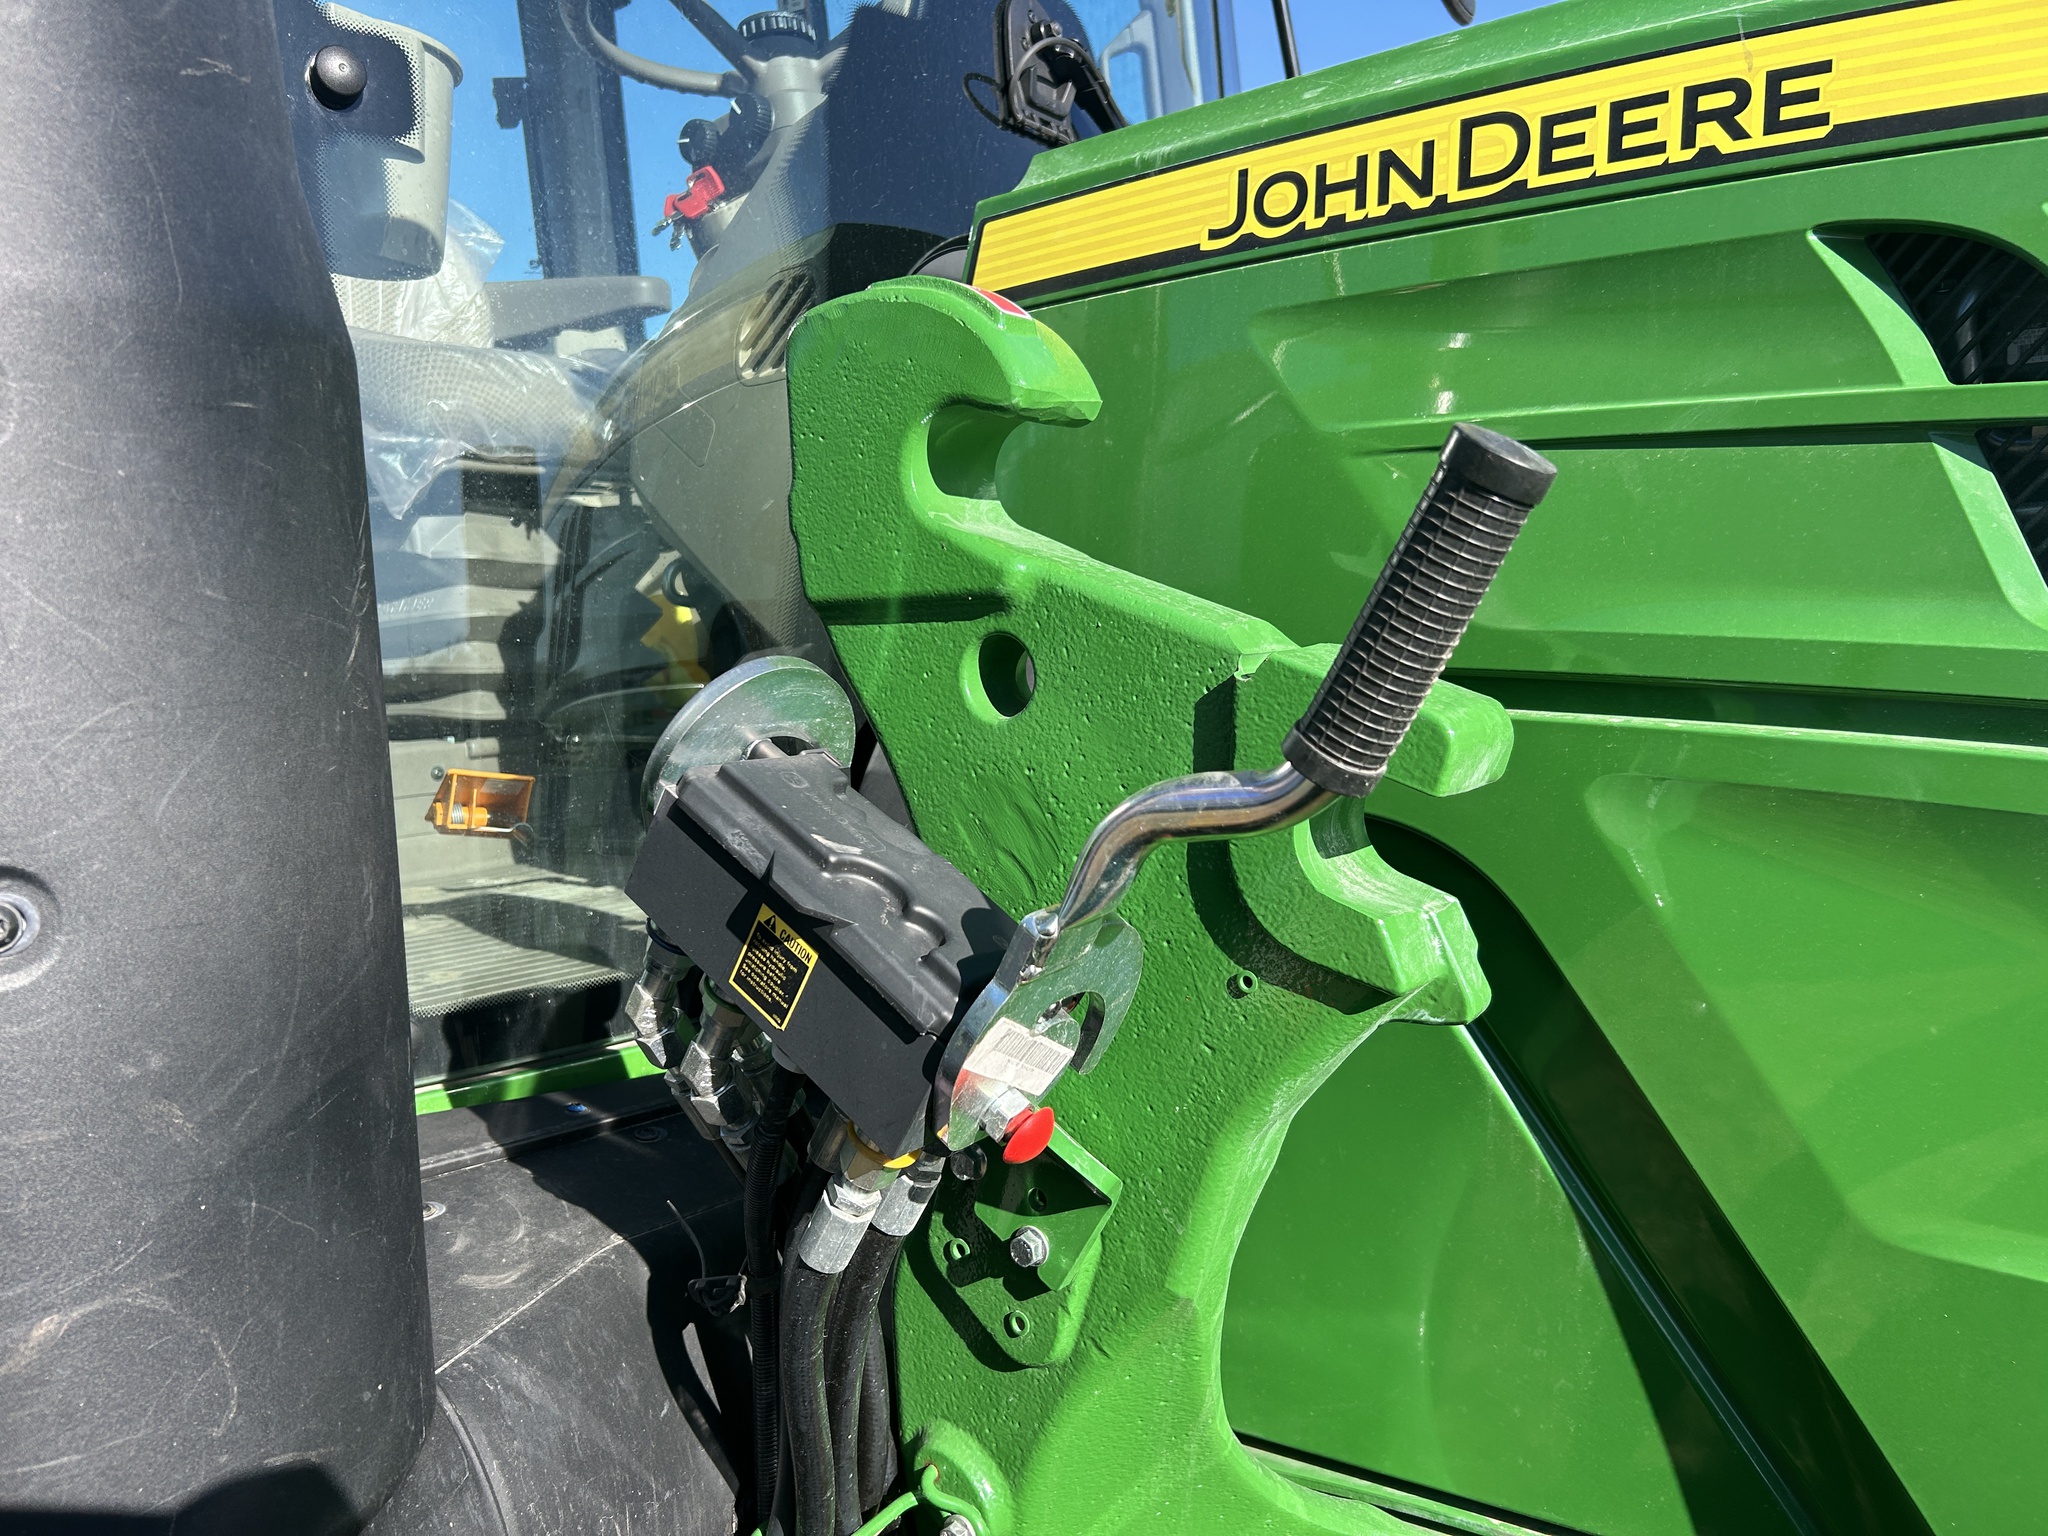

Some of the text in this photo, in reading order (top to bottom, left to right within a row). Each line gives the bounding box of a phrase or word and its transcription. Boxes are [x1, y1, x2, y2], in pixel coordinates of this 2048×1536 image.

[1208, 60, 1833, 241] JOHN DEERE
[772, 947, 787, 965] injury
[785, 959, 798, 974] from
[779, 928, 812, 965] CAUTION
[746, 950, 781, 985] pressure before
[771, 990, 789, 1009] manual
